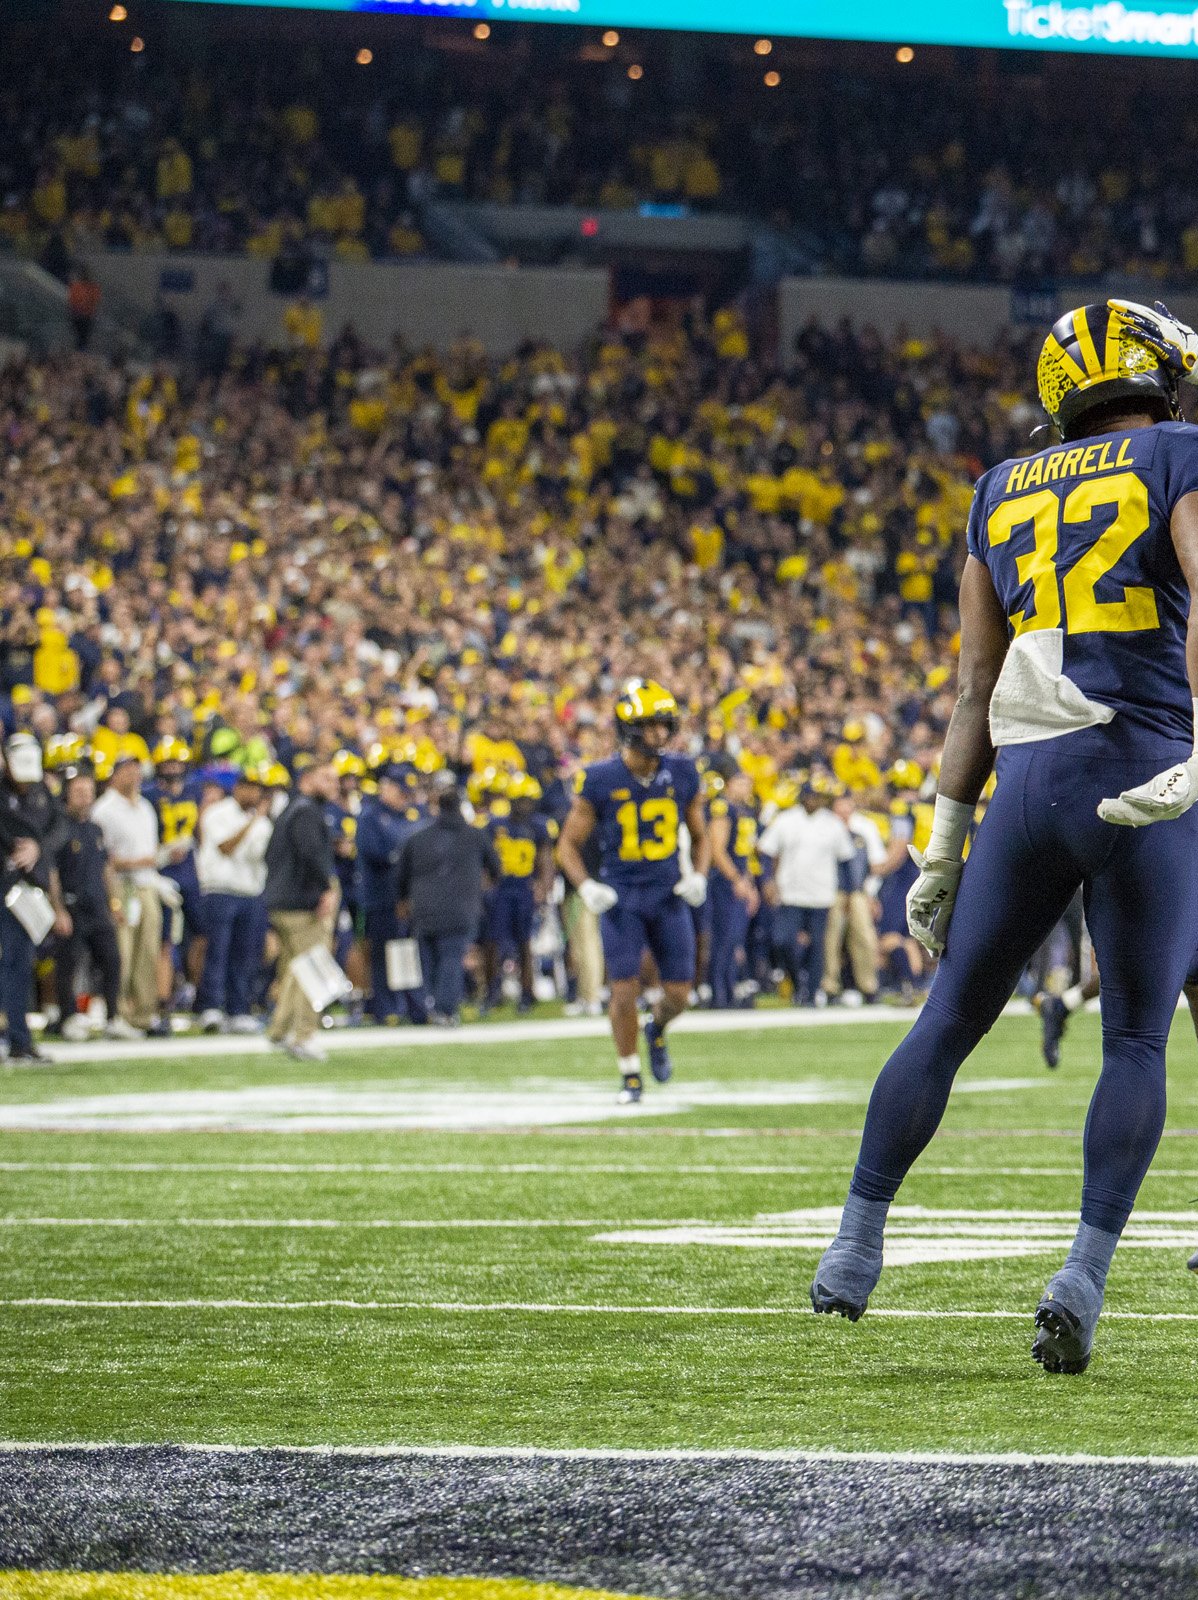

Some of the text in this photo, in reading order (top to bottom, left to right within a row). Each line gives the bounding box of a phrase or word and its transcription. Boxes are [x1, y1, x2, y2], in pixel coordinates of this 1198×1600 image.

[1005, 438, 1135, 494] HARRELL
[987, 472, 1160, 635] 32
[616, 798, 678, 861] 13
